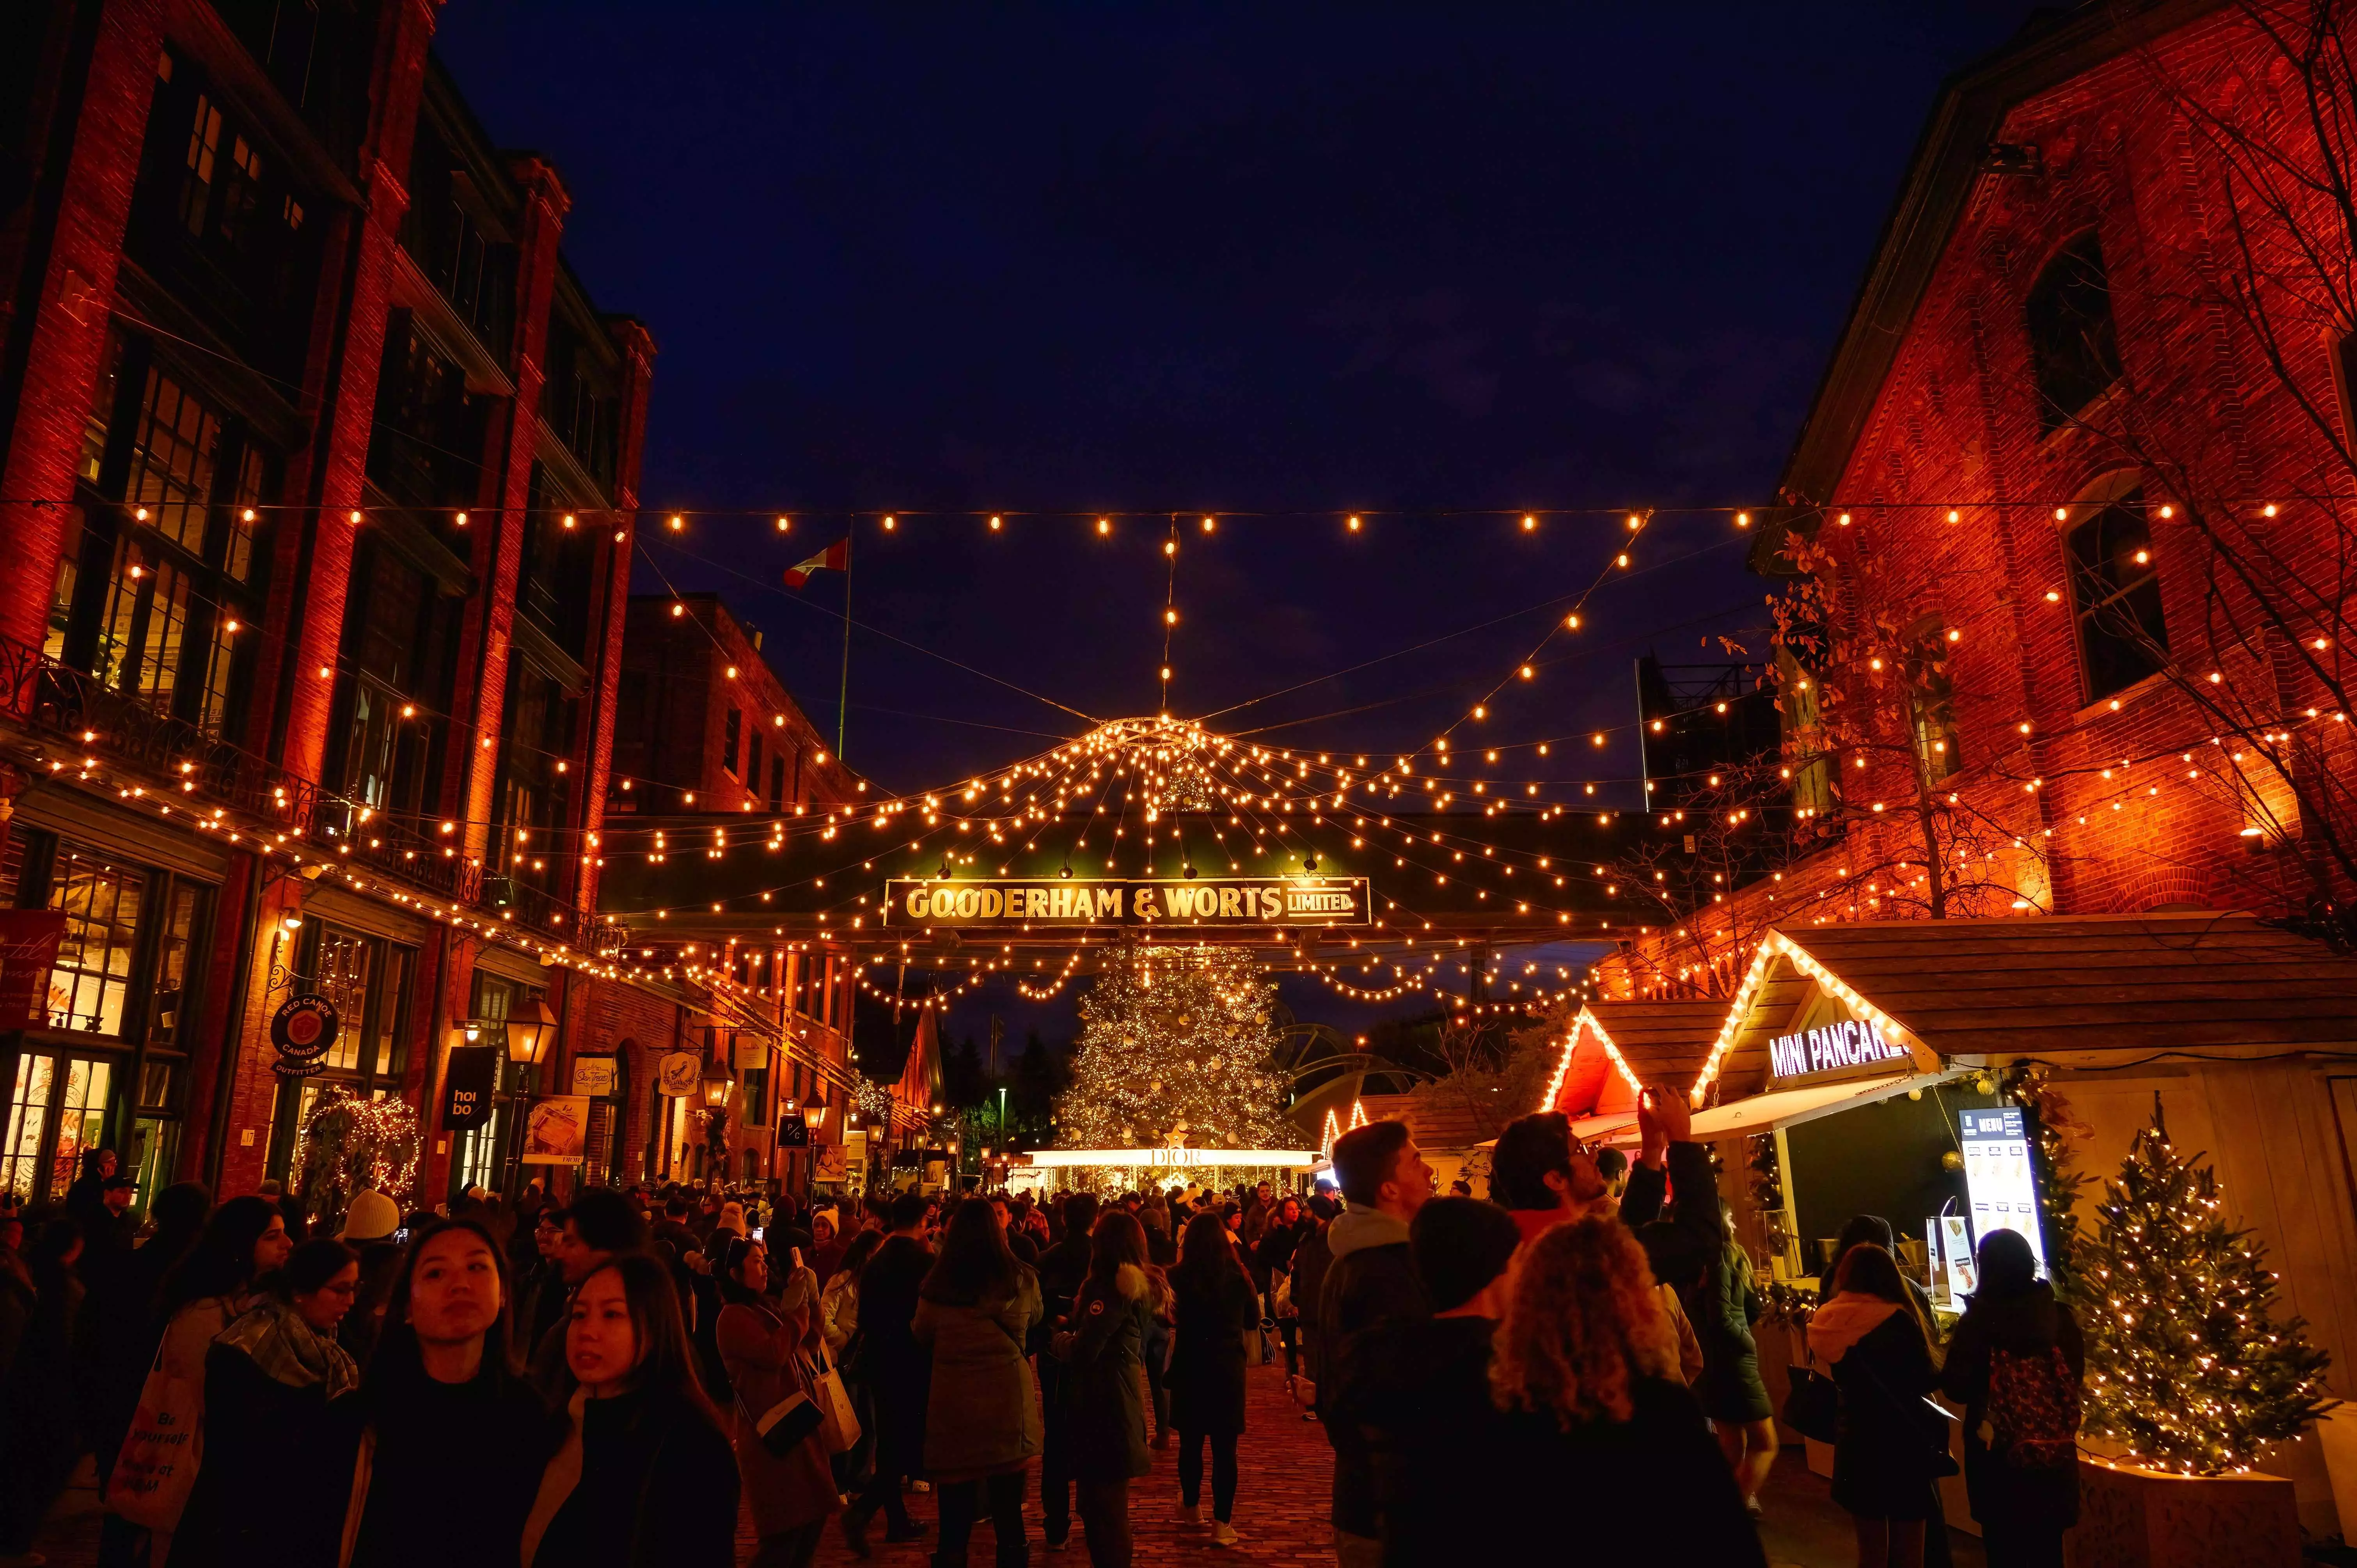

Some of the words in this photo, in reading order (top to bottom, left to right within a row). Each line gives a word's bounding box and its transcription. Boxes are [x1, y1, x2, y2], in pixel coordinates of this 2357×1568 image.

[907, 887, 1123, 918] GOODERHAM
[1133, 887, 1162, 918] &
[1163, 886, 1282, 917] WORTS
[1287, 894, 1352, 911] LIMITED
[281, 1000, 300, 1017] RED
[303, 998, 332, 1018] CANOE
[282, 1044, 321, 1056] CANADA
[1769, 1032, 1808, 1077] MINI
[276, 1065, 321, 1075] OUTFITTER
[453, 1103, 472, 1115] bo
[1978, 1117, 2004, 1132] MENU
[1152, 1150, 1202, 1165] DIOR
[158, 1412, 176, 1426] Be
